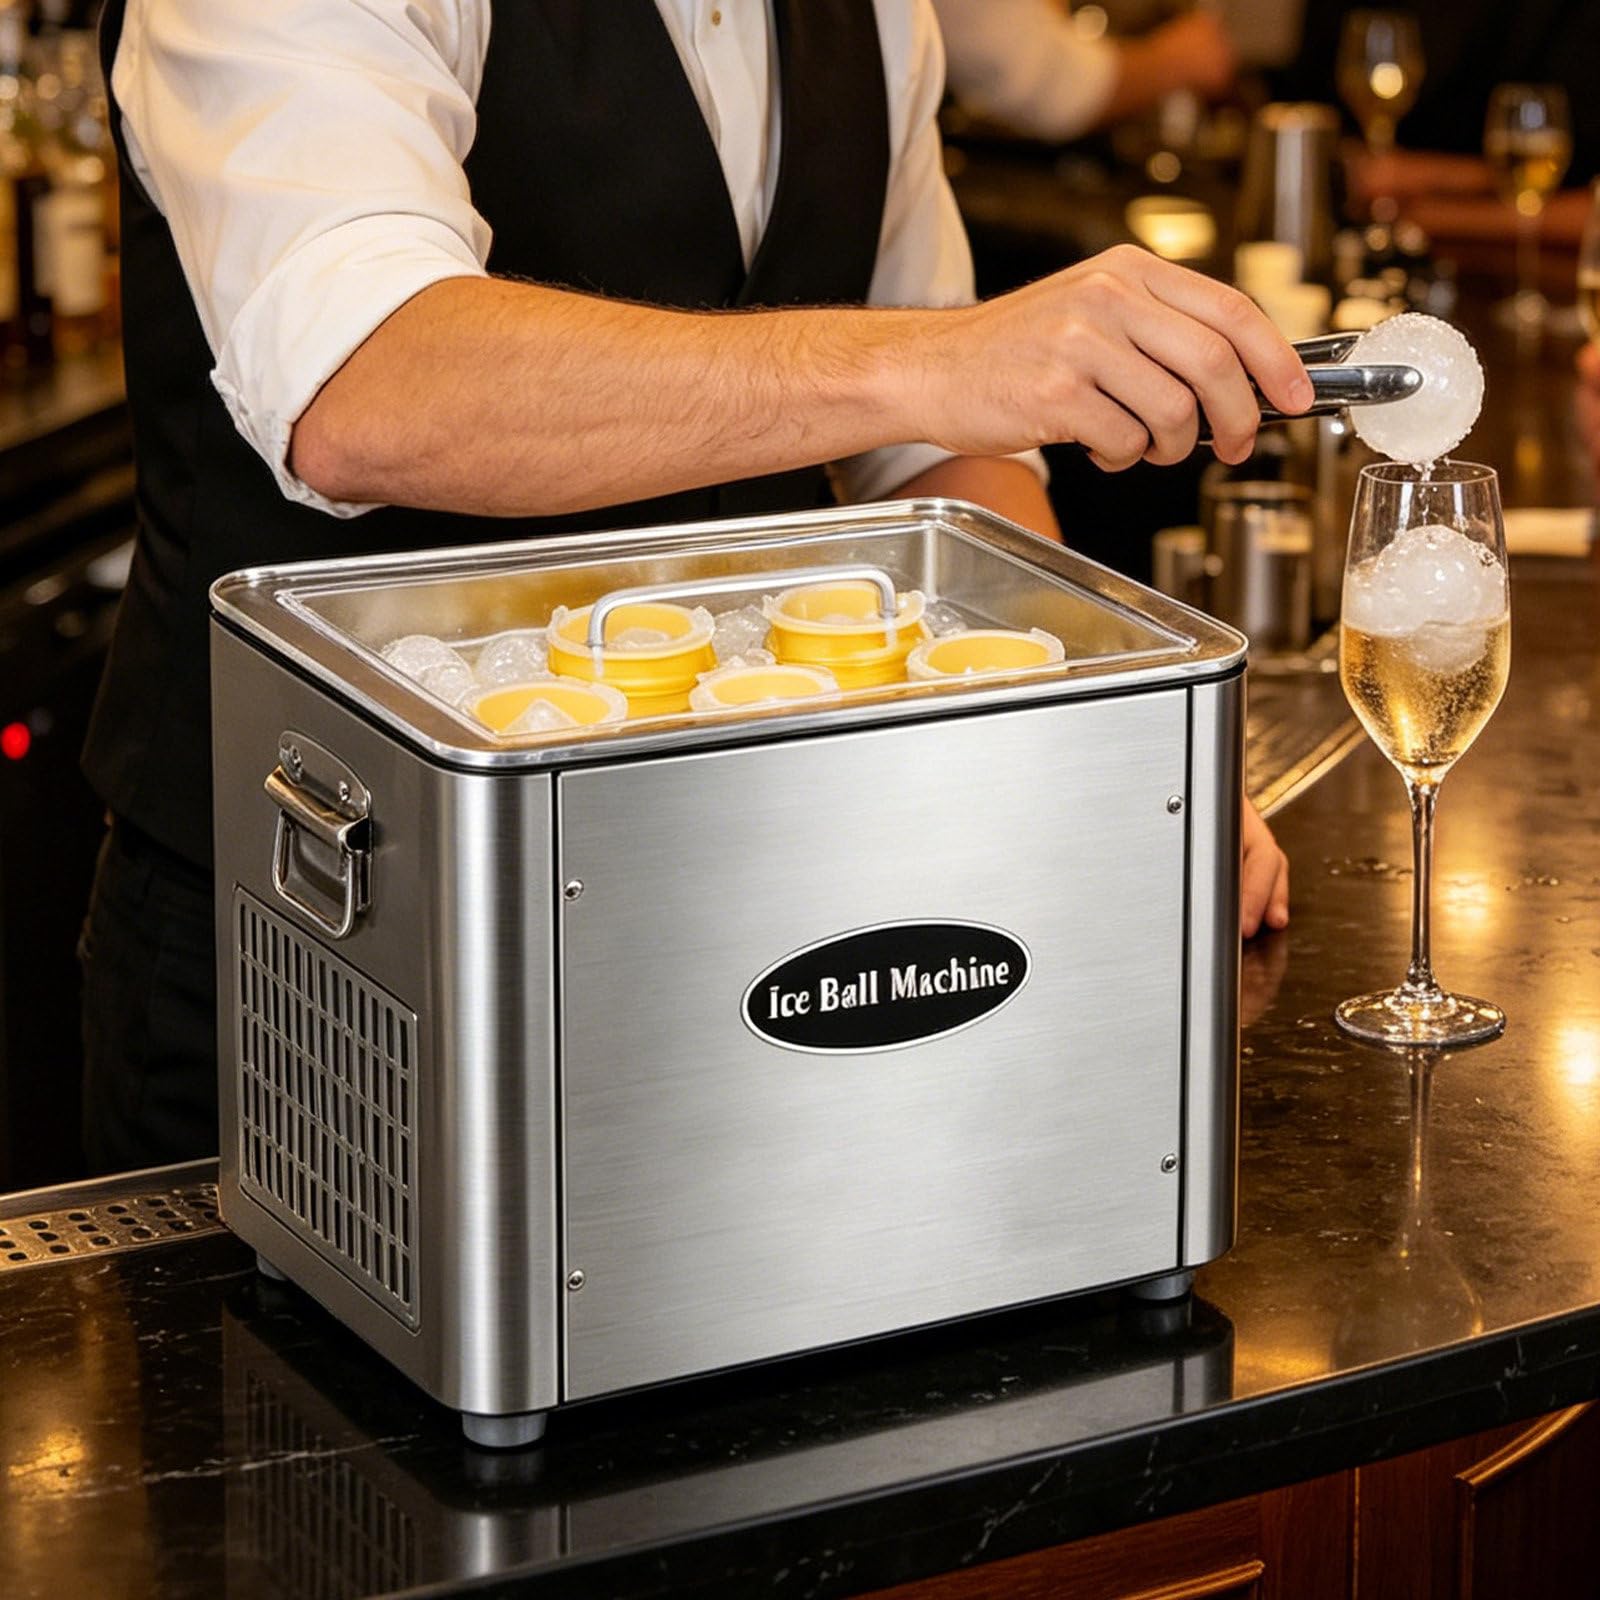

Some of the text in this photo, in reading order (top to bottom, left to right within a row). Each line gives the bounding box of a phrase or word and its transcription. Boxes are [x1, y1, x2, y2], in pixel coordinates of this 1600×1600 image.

[768, 956, 1010, 1019] Ice Ball Machine
